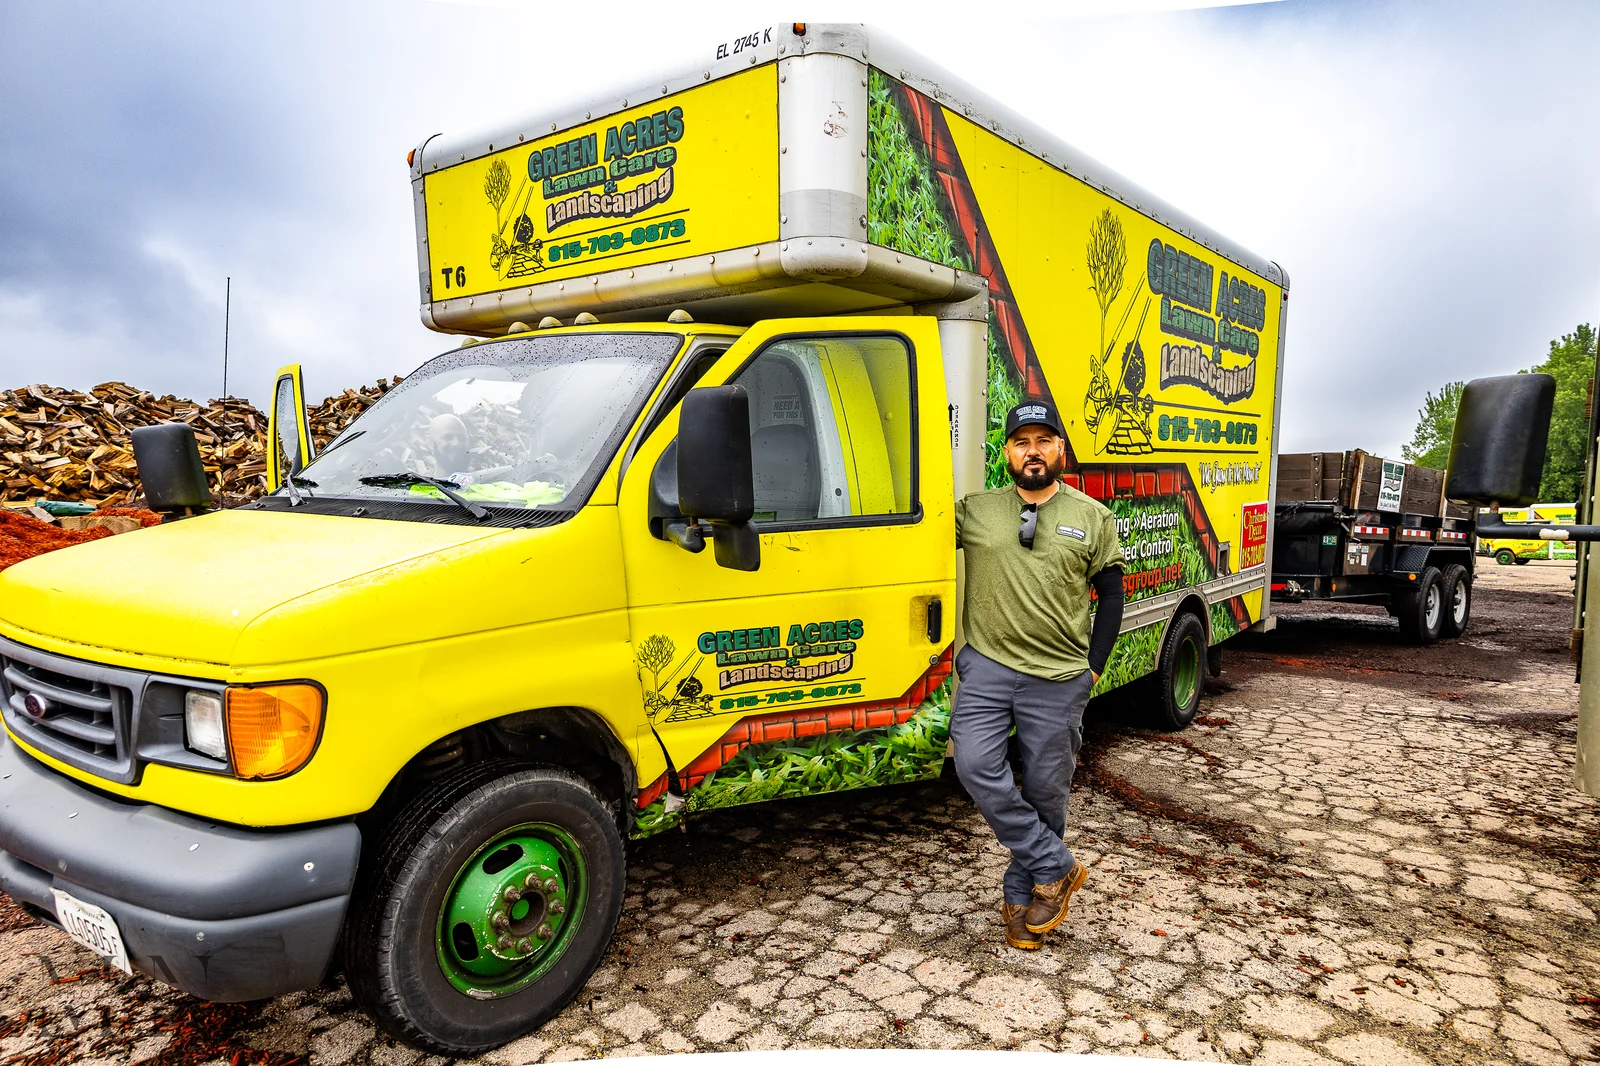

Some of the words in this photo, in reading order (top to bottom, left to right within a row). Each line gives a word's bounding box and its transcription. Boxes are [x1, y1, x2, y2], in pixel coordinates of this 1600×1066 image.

[716, 44, 730, 60] EL
[733, 32, 759, 55] 2745
[763, 27, 772, 43] K
[528, 133, 597, 183] GREEN
[603, 105, 685, 164] ACRES
[541, 163, 605, 199] Lawn
[610, 145, 677, 180] Care
[604, 181, 618, 195] &
[545, 168, 675, 231] Landscaping
[548, 218, 686, 263] 815-703-0873
[1147, 238, 1214, 314] GREEN
[1215, 271, 1266, 332] ACRES
[1160, 298, 1215, 345] Lawn
[1218, 318, 1259, 357] Care
[1212, 343, 1222, 364] &
[1160, 343, 1256, 404] Landscaping
[772, 411, 785, 419] FOR
[786, 411, 799, 419] THIS
[774, 401, 793, 411] NEED
[1158, 414, 1257, 445] 815-703-0873
[1113, 513, 1130, 538] ing
[1140, 509, 1179, 531] Aeration
[1140, 534, 1174, 558] Control
[1122, 559, 1182, 598] sgroup.net
[698, 626, 781, 654] GREEN
[787, 619, 863, 647] ACRES
[716, 648, 788, 667] Lawn
[792, 641, 856, 657] Care
[786, 657, 800, 667] &
[719, 653, 854, 690] Landscaping
[719, 683, 862, 710] 815-703-0873
